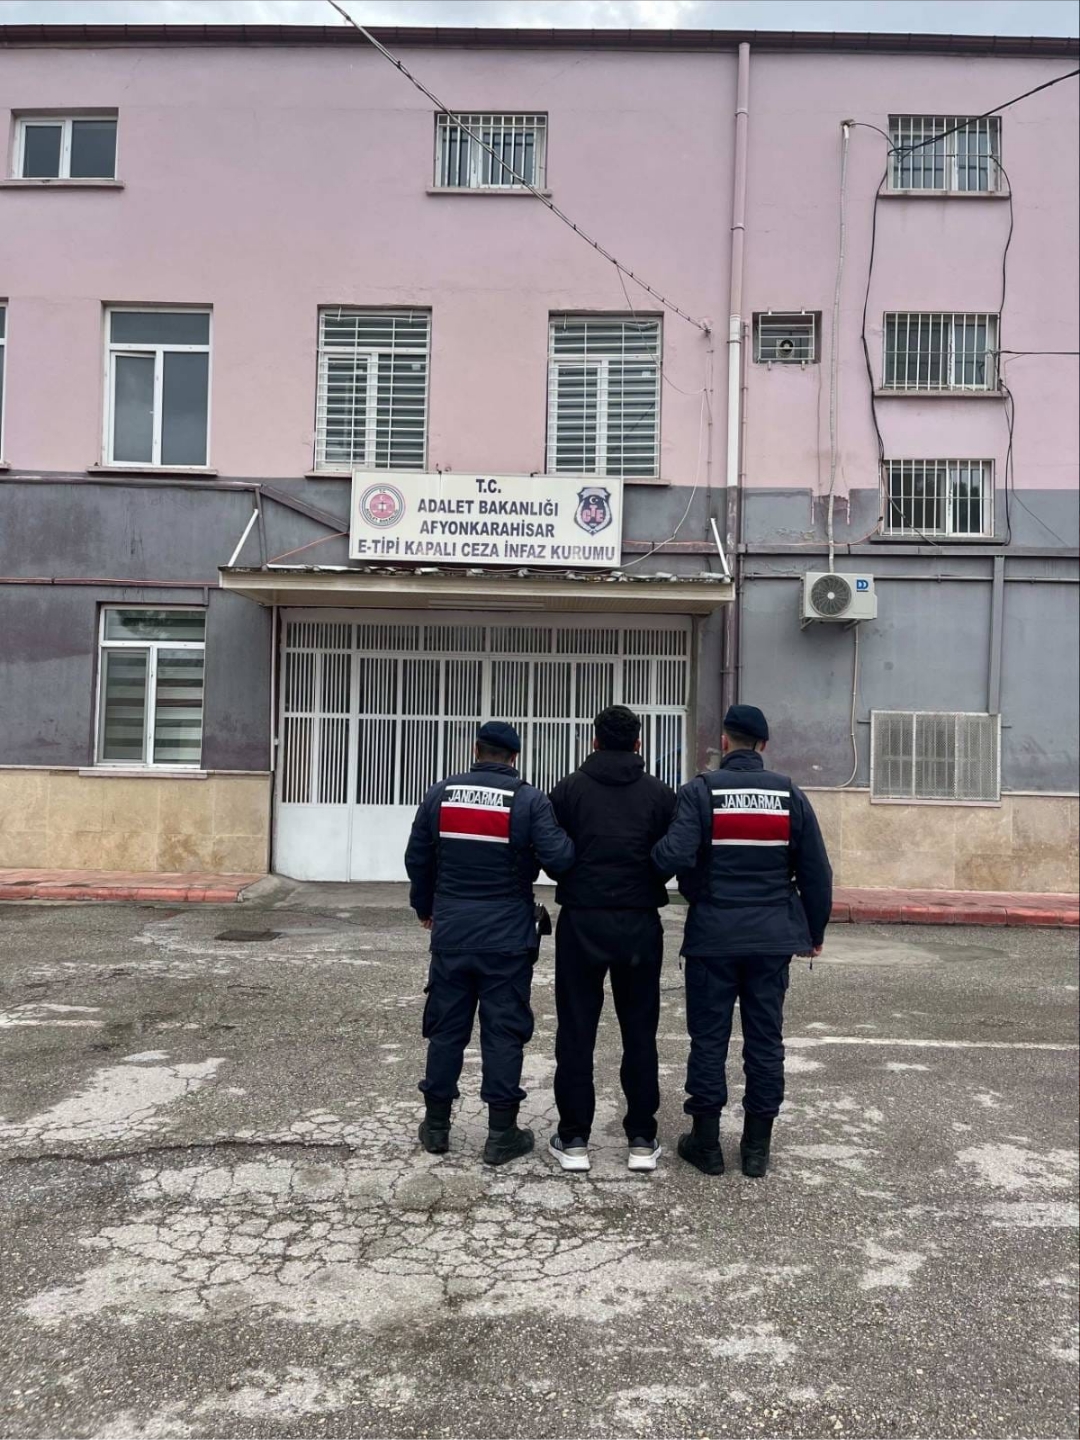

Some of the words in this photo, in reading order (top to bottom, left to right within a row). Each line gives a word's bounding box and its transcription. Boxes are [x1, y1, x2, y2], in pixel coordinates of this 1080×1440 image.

[475, 478, 502, 494] T.C.
[417, 498, 475, 515] ADALET
[478, 498, 559, 517] BAKANLIĞI
[419, 519, 555, 538] AFYONKARAHİSAR
[357, 535, 400, 554] E-TİPİ
[404, 541, 457, 557] KAPALI
[461, 542, 500, 558] CEZA
[503, 539, 546, 559] İNFAZ
[550, 544, 615, 560] KURUMU
[448, 789, 504, 807] JANDARMA
[721, 794, 783, 810] JANDARMA
